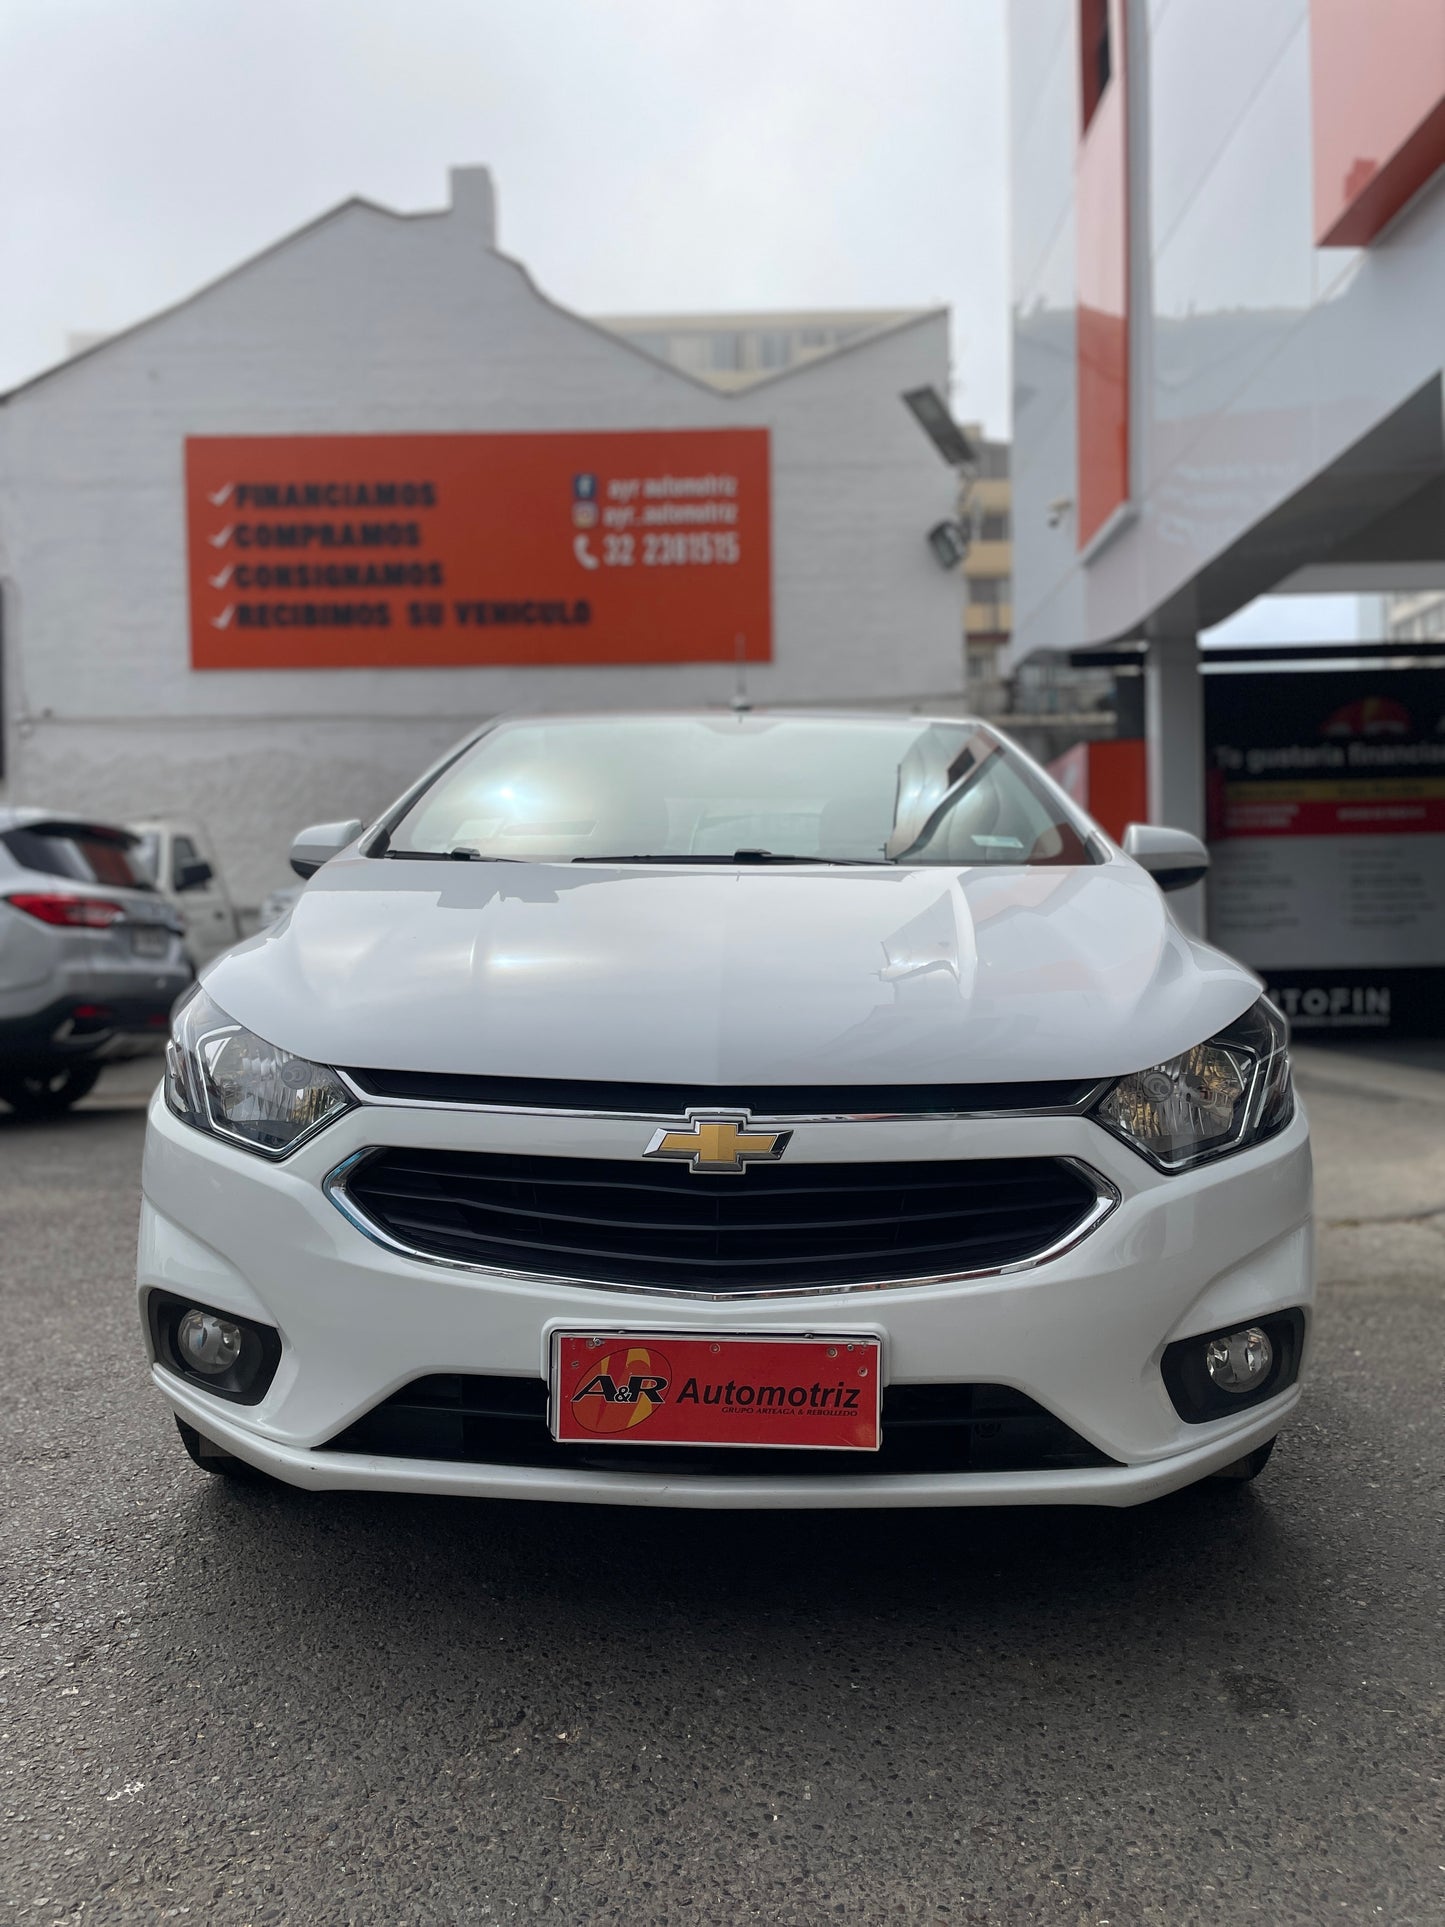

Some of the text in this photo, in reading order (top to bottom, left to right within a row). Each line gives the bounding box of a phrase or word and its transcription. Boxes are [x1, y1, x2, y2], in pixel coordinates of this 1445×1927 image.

[235, 482, 436, 508] FINANCIAMOS
[643, 474, 738, 498] automotriz
[235, 520, 420, 547] COMPRAMOS
[603, 532, 636, 566] 32
[235, 562, 443, 588] CONSIGNAMOS
[236, 599, 592, 628] RECIBIMOS SU VEHICULO
[570, 1374, 861, 1409] A&R Automotriz
[721, 1406, 858, 1417] GRUPO ARTEAGA & REBOLLEDO
